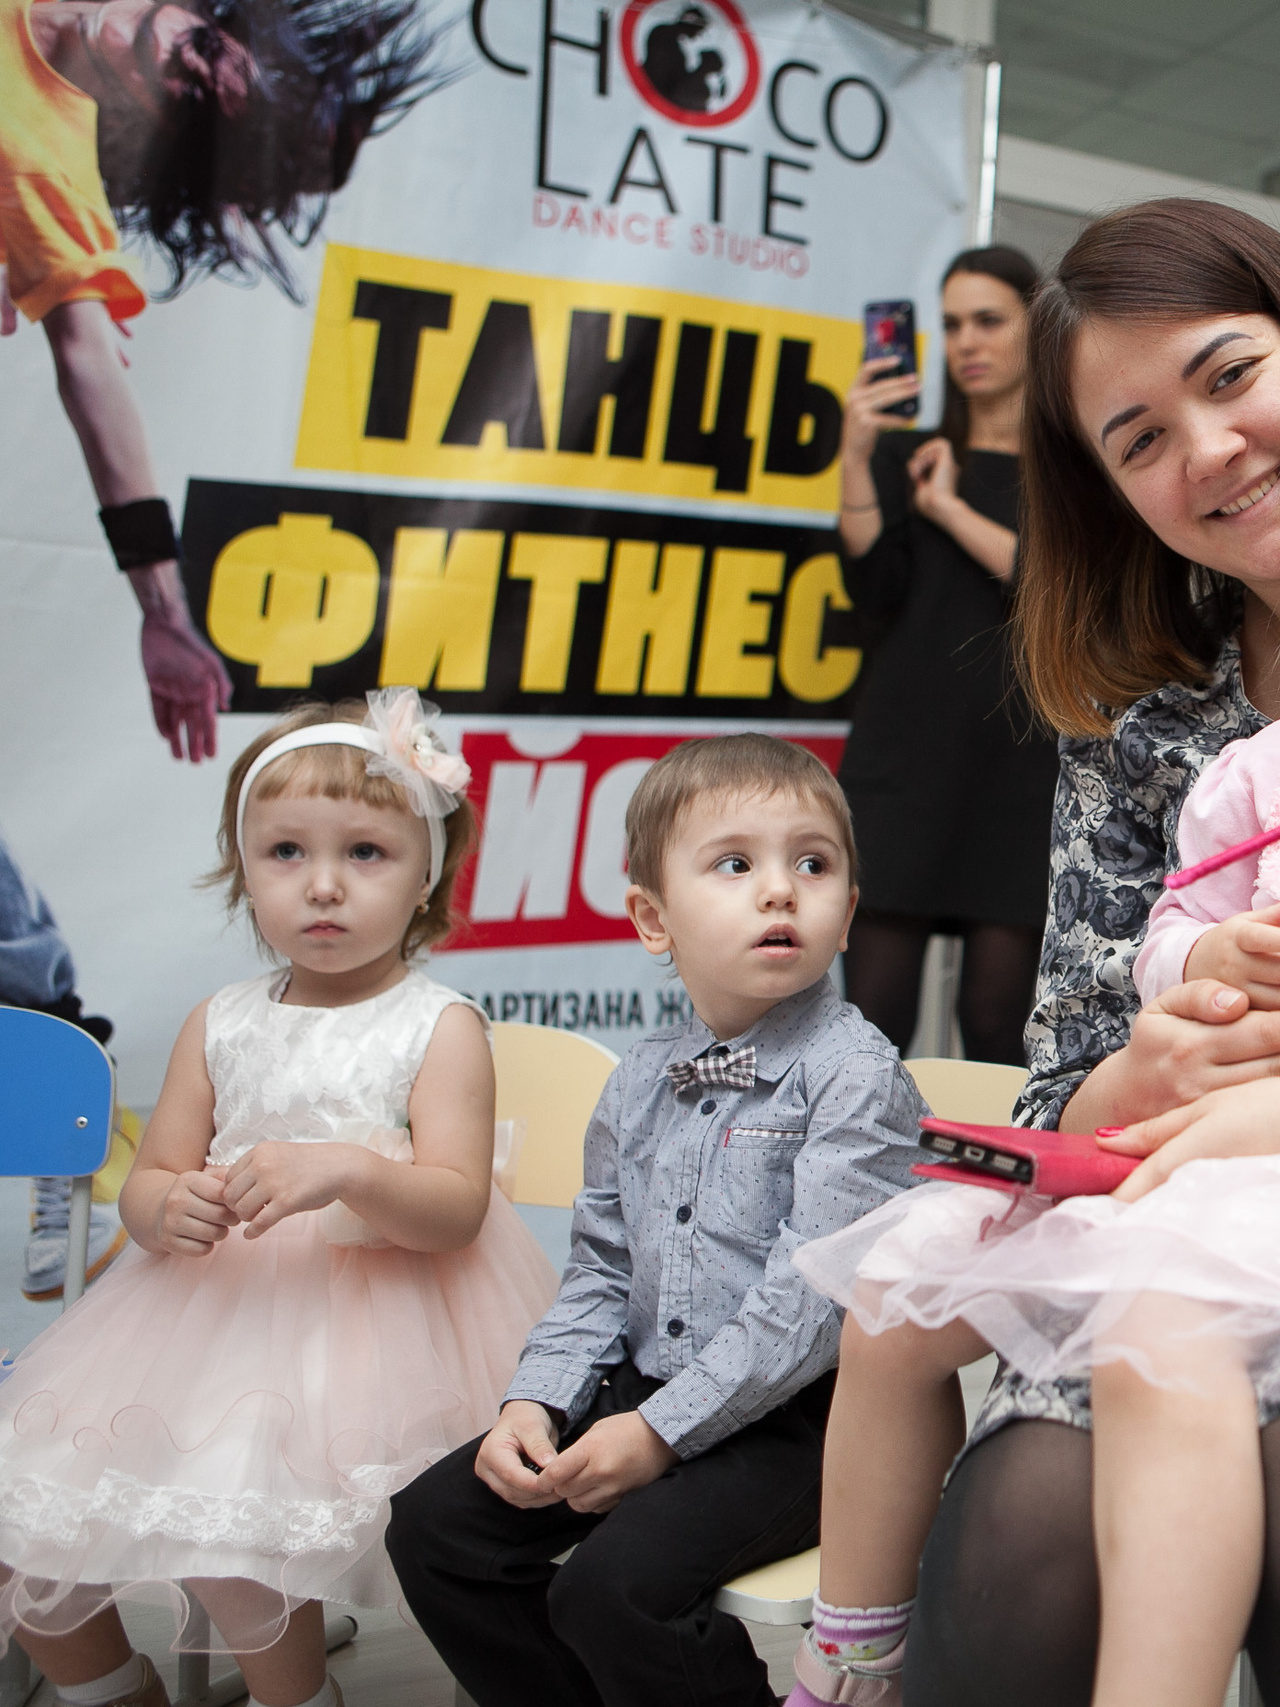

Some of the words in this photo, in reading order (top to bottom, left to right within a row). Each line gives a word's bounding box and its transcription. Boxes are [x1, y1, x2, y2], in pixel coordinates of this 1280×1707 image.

[532, 192, 675, 250] DANCE
[689, 222, 810, 278] STUDIO
[535, 126, 812, 245] LATE
[206, 513, 863, 702] ФИТНЕС
[458, 988, 645, 1030] АРТИЗАНА
